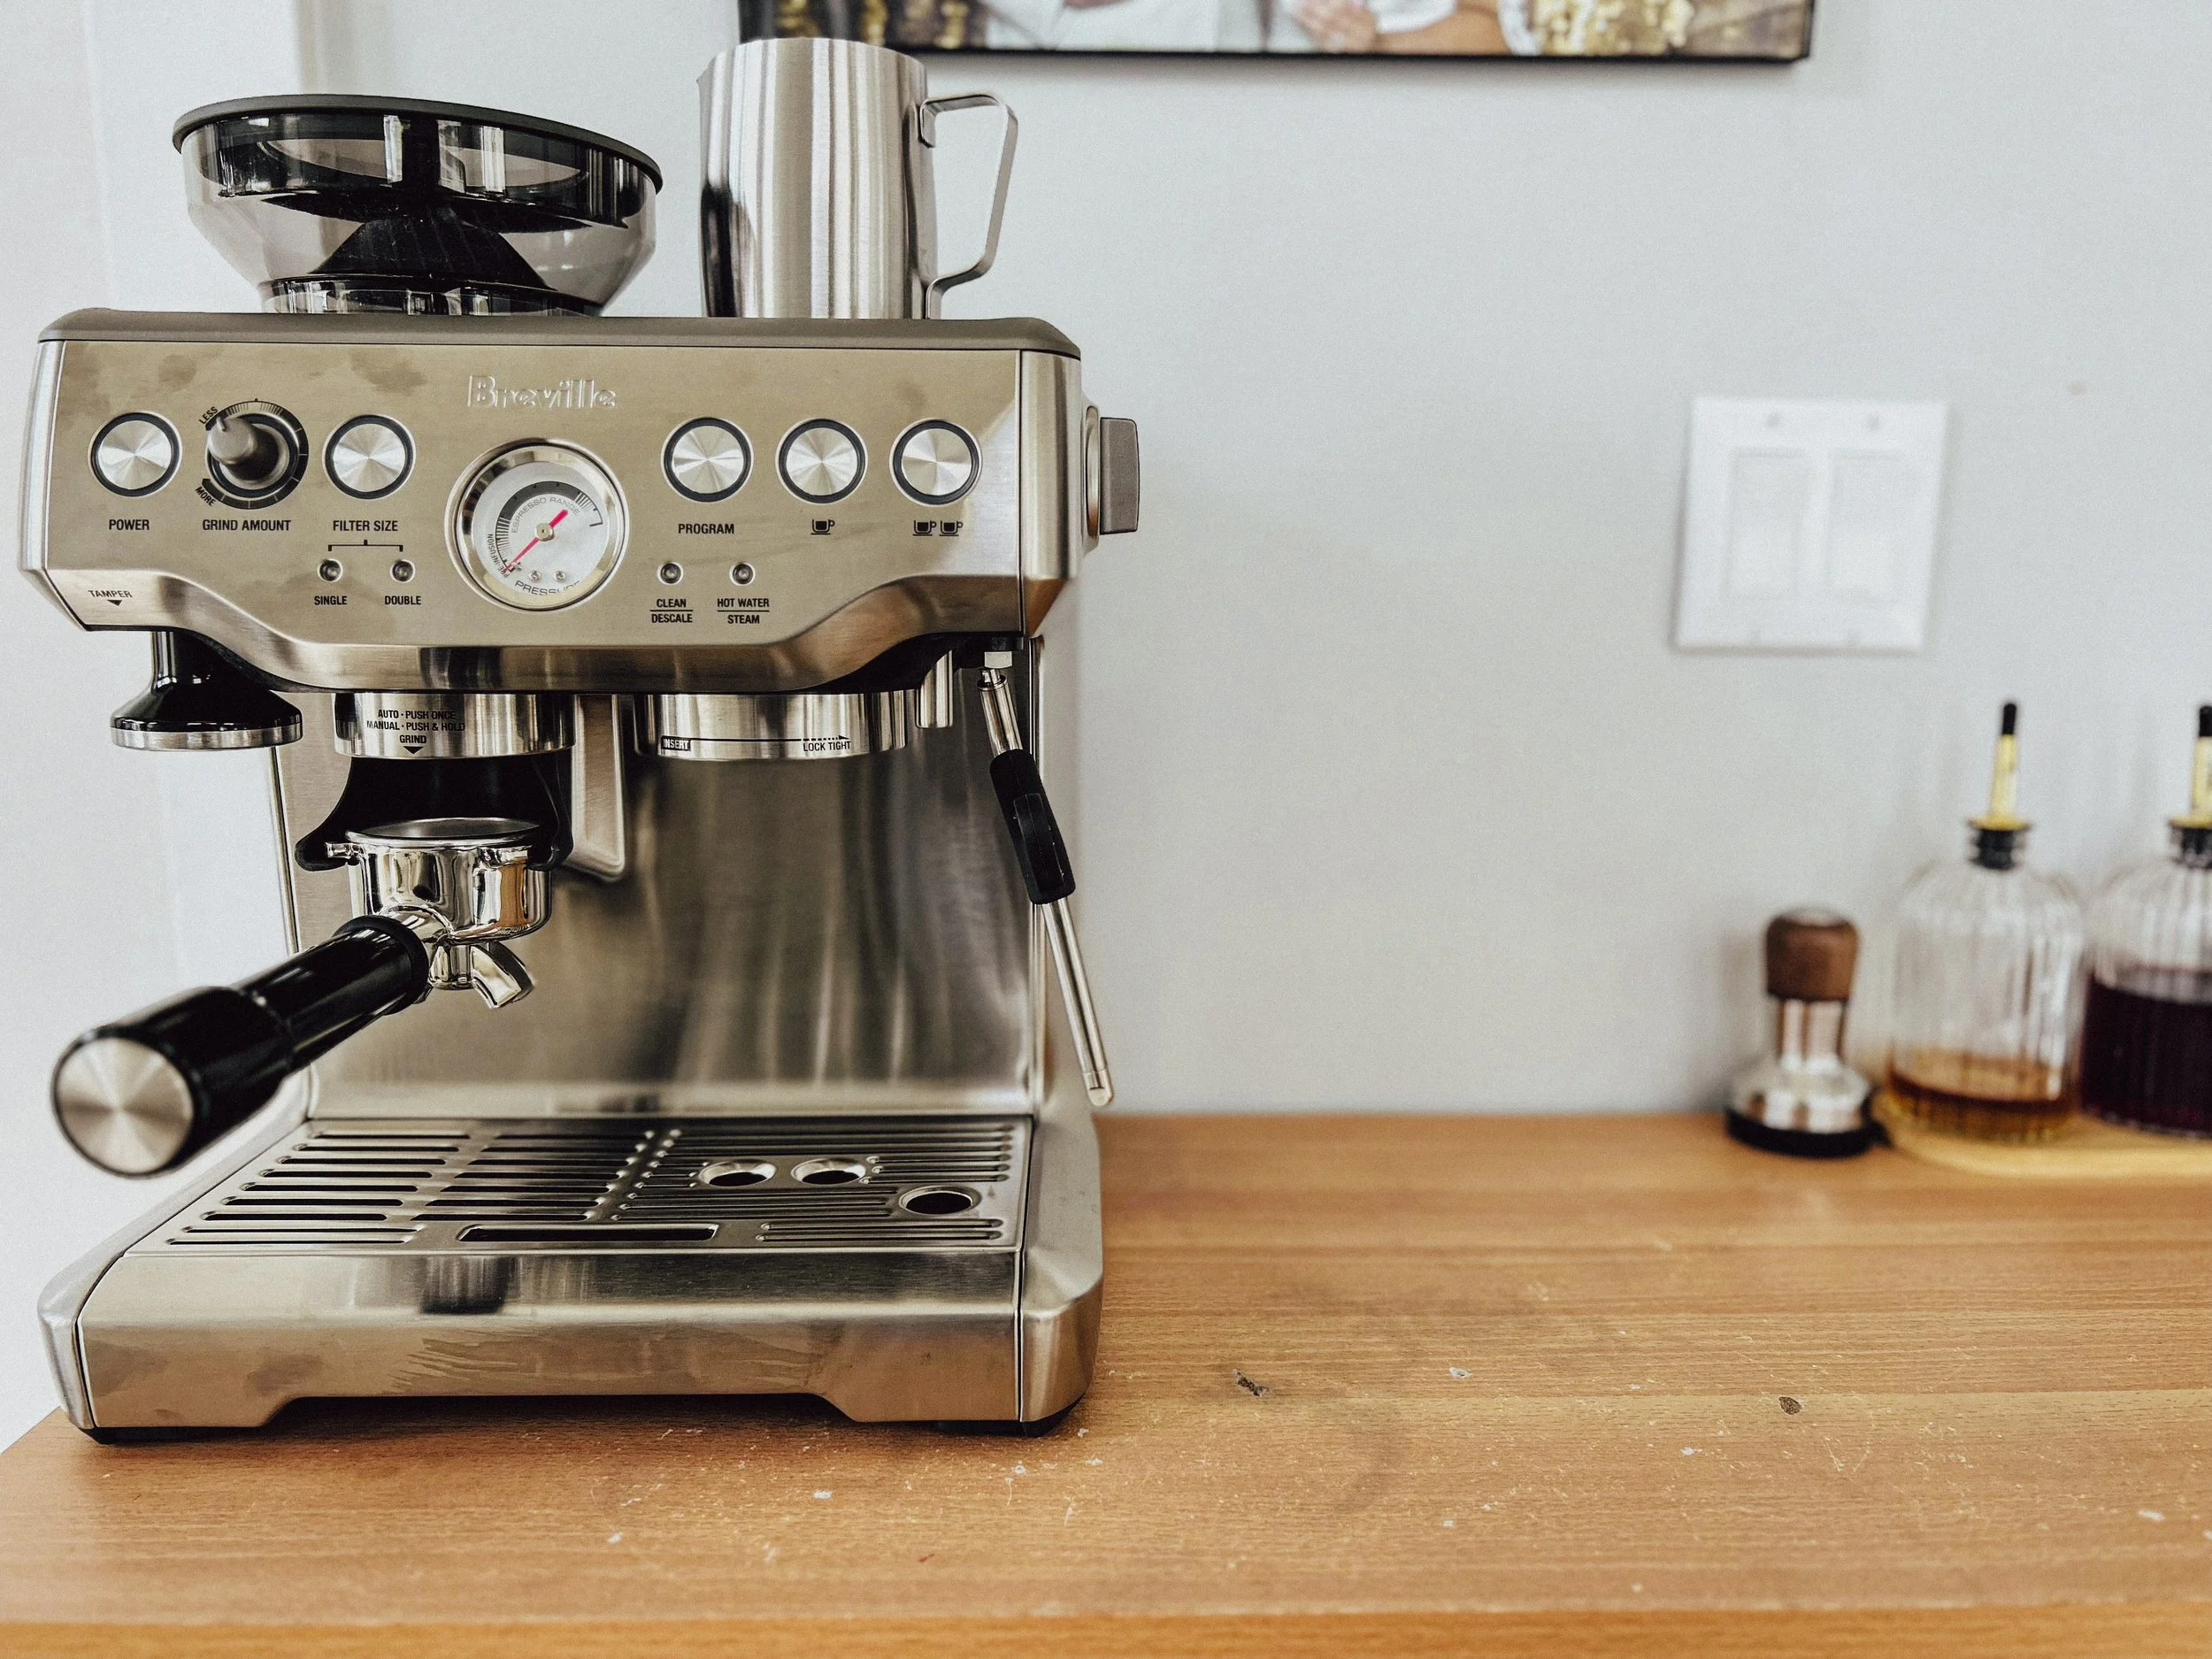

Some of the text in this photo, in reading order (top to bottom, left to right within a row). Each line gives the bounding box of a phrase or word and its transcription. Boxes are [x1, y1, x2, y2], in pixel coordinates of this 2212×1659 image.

[467, 375, 617, 409] Breville
[198, 405, 219, 426] LESS
[195, 486, 217, 507] MORE
[511, 496, 580, 533] ESPRESSO RANGE
[109, 519, 150, 531] POWER
[203, 519, 291, 531] GRIND AMOUNT
[333, 520, 398, 531] FILTER SIZE
[678, 524, 735, 534] PROGRAM
[88, 589, 133, 598] TAMPER
[314, 595, 348, 605] SINGLE
[384, 595, 421, 605] DOUBLE
[657, 598, 687, 608] CLEAN
[717, 598, 770, 608] HOT WATER
[651, 613, 693, 624] DESCALE
[727, 614, 760, 625] STEAM
[378, 710, 457, 720] AUTO PUSH ONCE
[366, 720, 465, 732] MANUAL PUSH & HOLD
[399, 734, 426, 744] GRIND
[663, 738, 689, 750] INSERT
[803, 741, 851, 752] LOCK TIGHT
